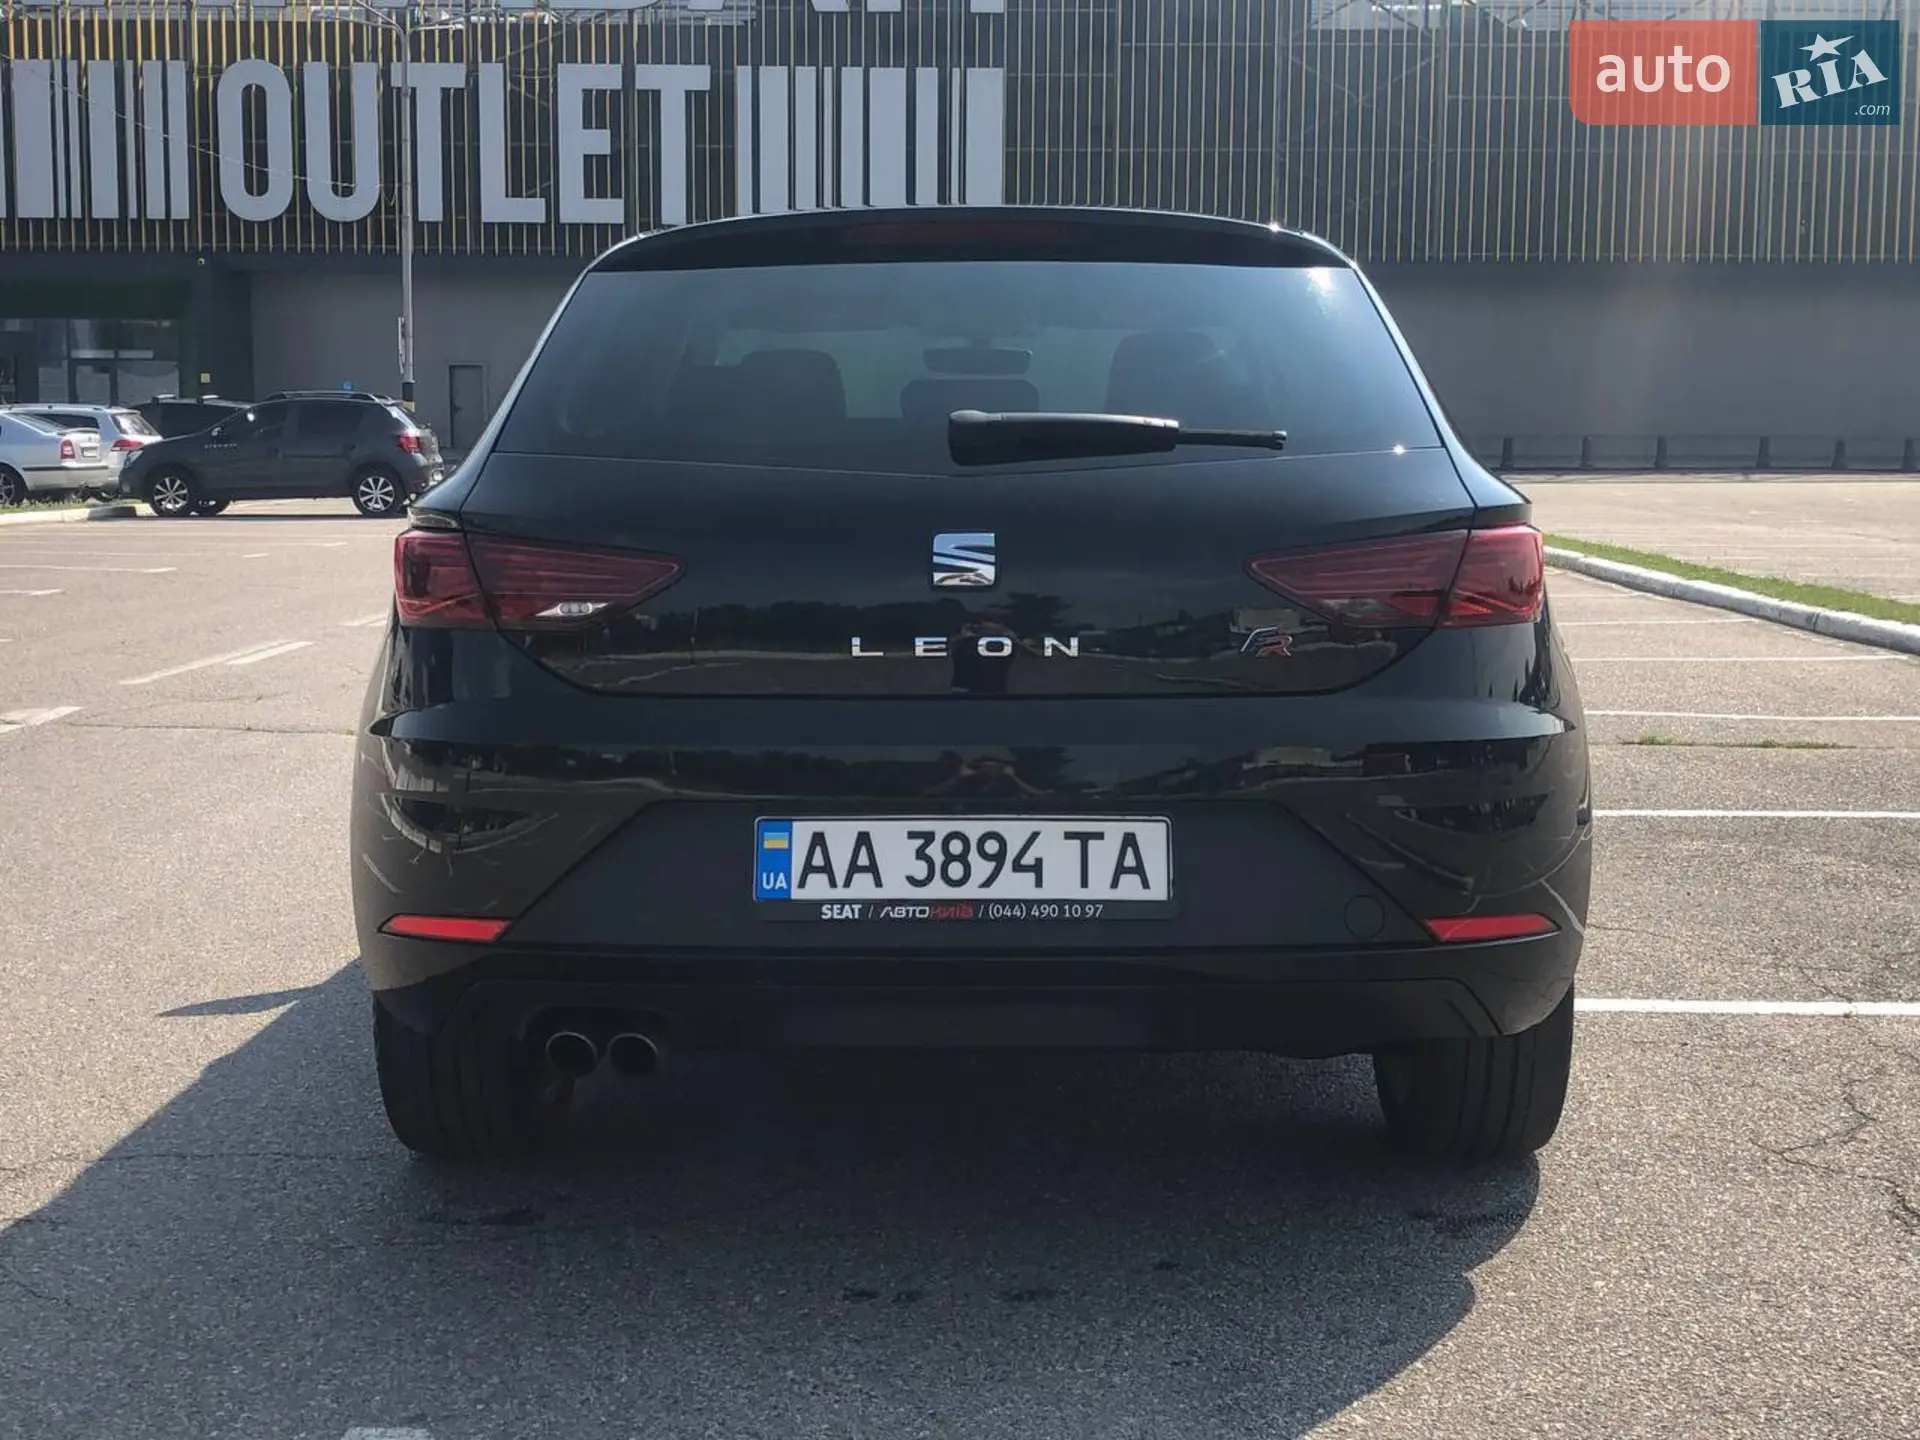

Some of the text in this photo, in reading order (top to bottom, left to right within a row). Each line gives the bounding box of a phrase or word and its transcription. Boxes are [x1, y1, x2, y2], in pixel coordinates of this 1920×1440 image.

[217, 58, 711, 225] OUTLET
[851, 636, 1079, 657] LEON
[797, 830, 1151, 889] AA 3894 TA
[762, 872, 788, 889] UA
[820, 904, 862, 919] SEAT
[988, 903, 1027, 920] (044)
[1030, 904, 1059, 918] 490
[1063, 904, 1082, 918] 10
[1085, 904, 1104, 918] 97
